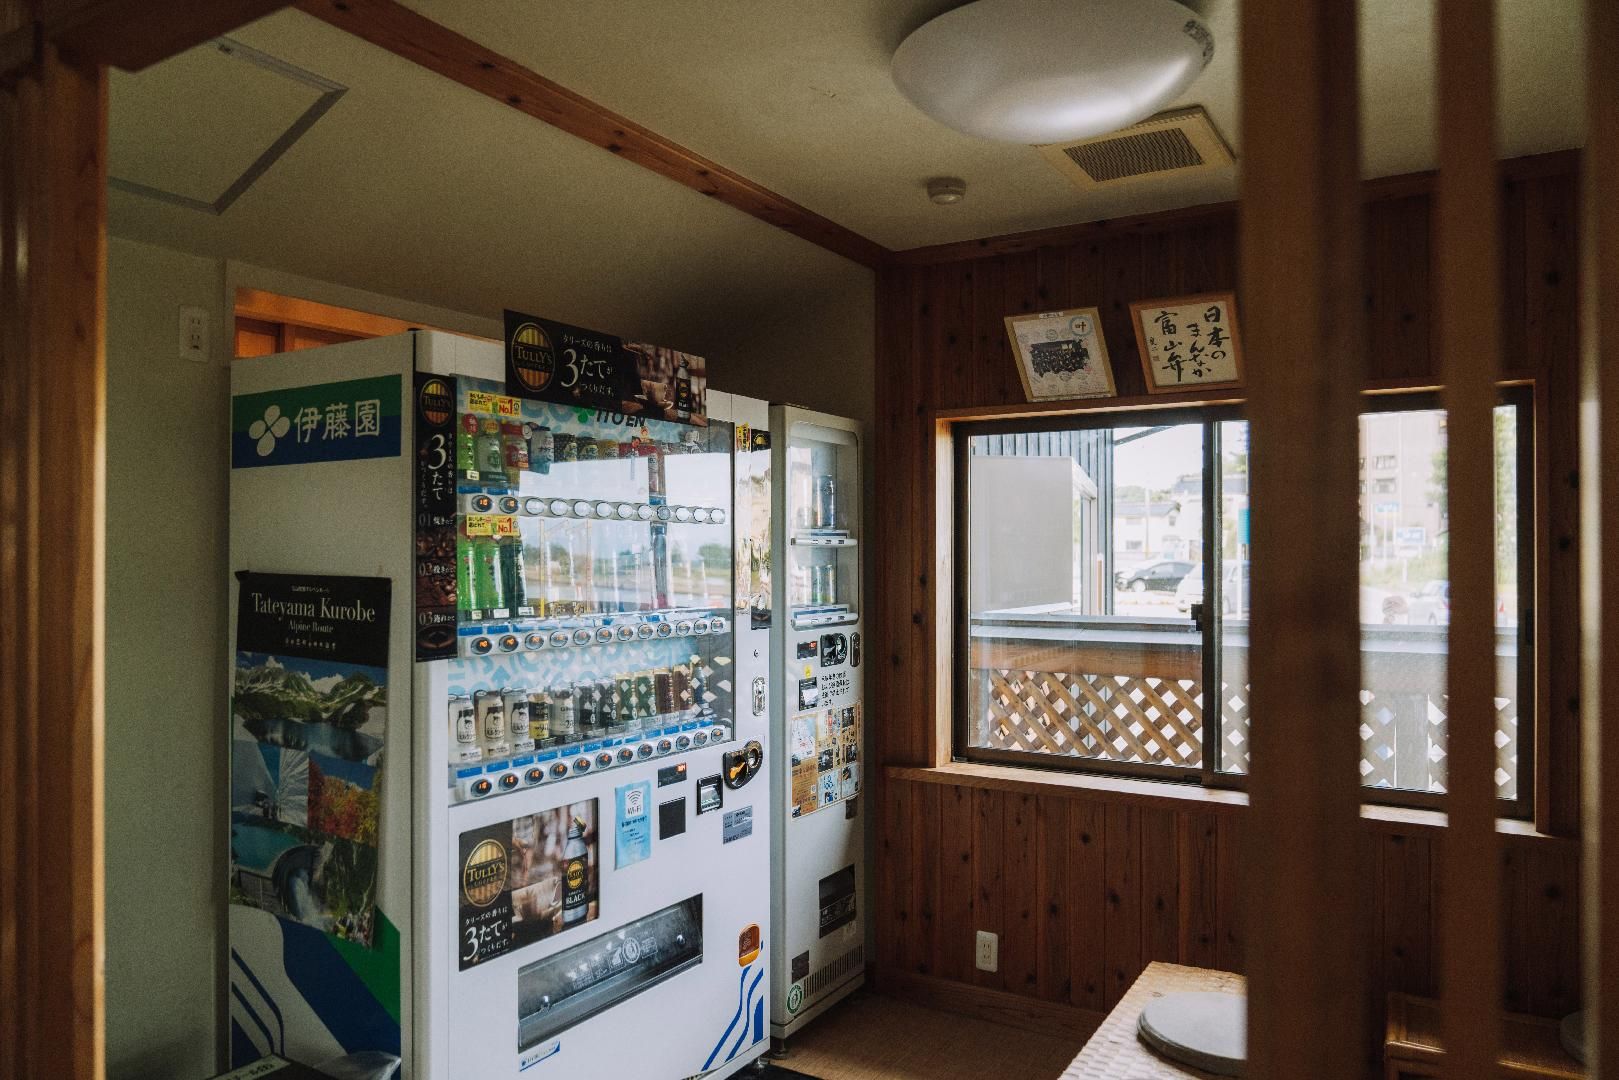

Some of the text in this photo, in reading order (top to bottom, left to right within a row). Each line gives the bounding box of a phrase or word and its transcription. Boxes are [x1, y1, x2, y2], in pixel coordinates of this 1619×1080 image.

[1203, 305, 1230, 361] 日本の
[515, 345, 552, 365] TULLY'S
[1154, 310, 1187, 382] 富山弁
[293, 399, 381, 443] 伊藤園
[498, 517, 512, 534] No.1
[251, 592, 376, 623] Tateyama Kurobe
[289, 619, 334, 634] Alpine Route
[467, 862, 505, 882] TULLY'S
[565, 892, 586, 905] BLACK
